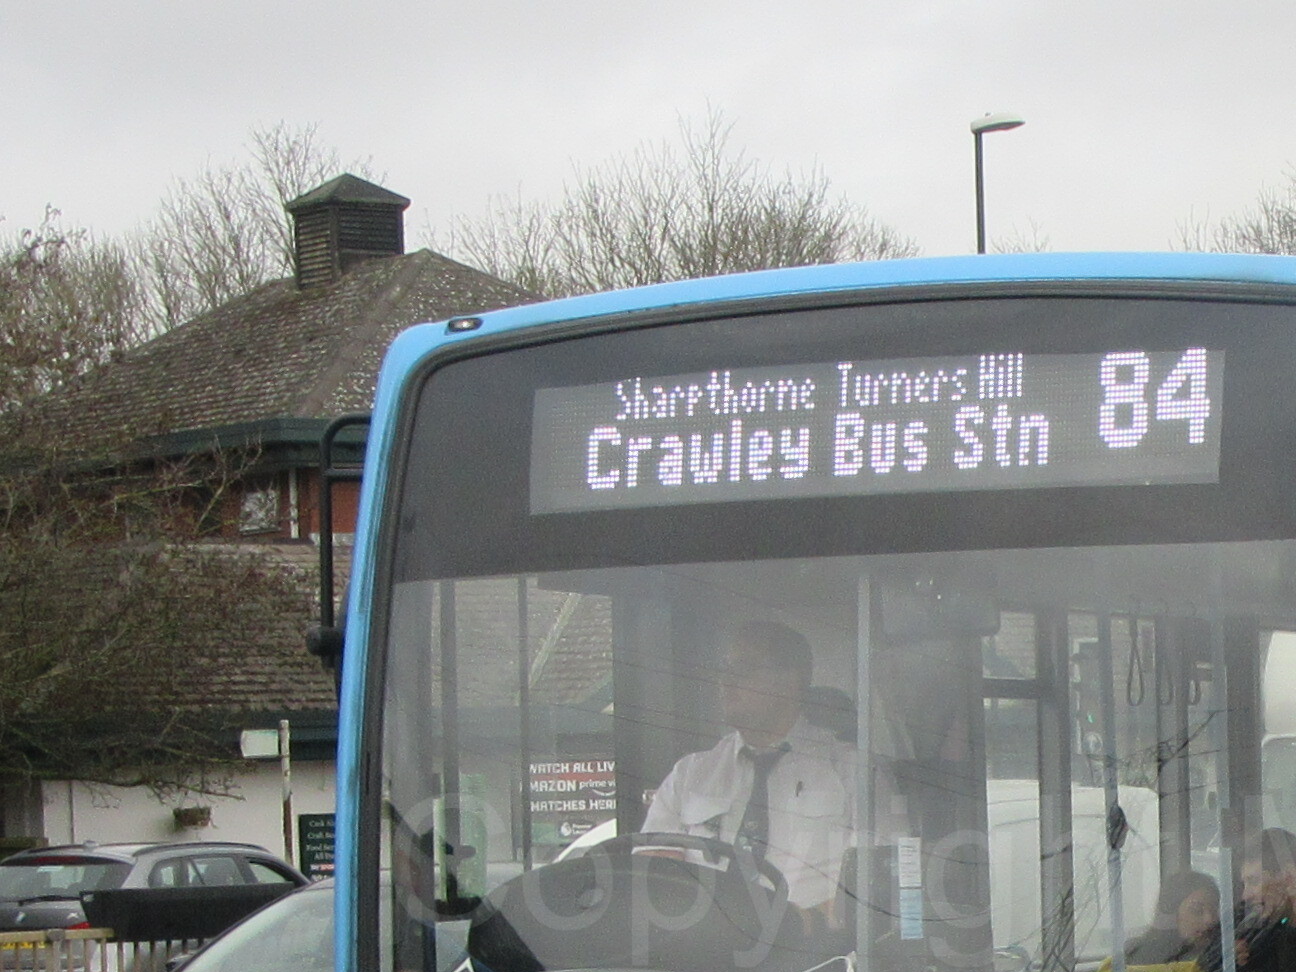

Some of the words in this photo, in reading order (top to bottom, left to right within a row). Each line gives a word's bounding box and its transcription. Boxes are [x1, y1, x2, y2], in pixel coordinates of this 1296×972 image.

[615, 370, 816, 420] Sharpthorne
[837, 362, 968, 408] Turners
[978, 352, 1023, 400] Hill
[1098, 346, 1211, 448] 84
[586, 419, 810, 490] Crawley
[832, 412, 928, 477] Bus
[953, 404, 1050, 468] Stn
[520, 779, 577, 792] MAZON
[579, 779, 607, 790] prime
[573, 762, 593, 773] ALL
[530, 799, 586, 812] MATCHES
